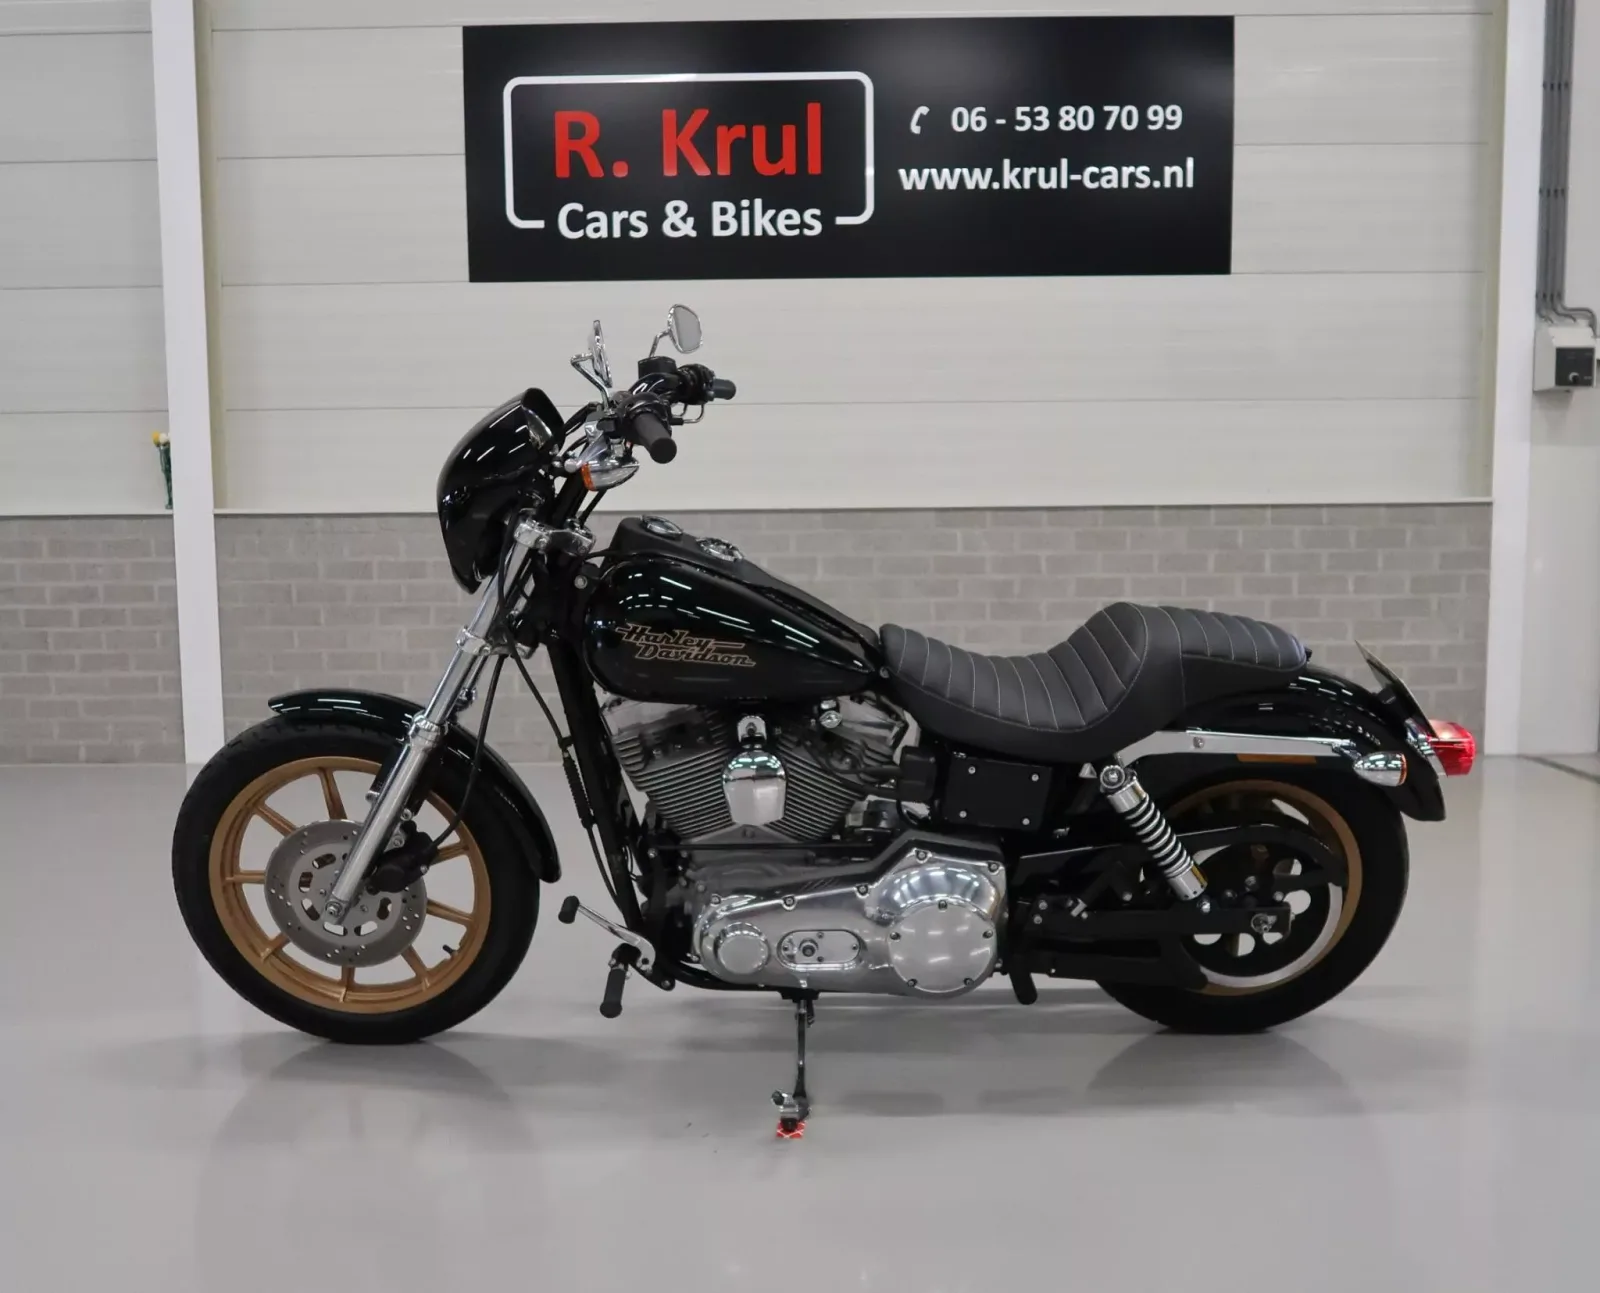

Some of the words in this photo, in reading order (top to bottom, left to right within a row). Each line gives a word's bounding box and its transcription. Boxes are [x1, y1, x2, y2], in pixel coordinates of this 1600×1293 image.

[951, 107, 987, 132] 06
[1015, 106, 1049, 131] 53
[1059, 106, 1094, 131] 80
[1104, 105, 1138, 130] 70
[1147, 105, 1182, 130] 99
[555, 111, 629, 178] R.
[663, 102, 822, 176] Krul
[898, 157, 1194, 190] www.krul-cars.nl
[558, 203, 648, 239] Cars
[662, 200, 697, 237] &
[712, 198, 822, 236] Bikes
[615, 623, 738, 650] Harley
[635, 643, 756, 667] Davidson
